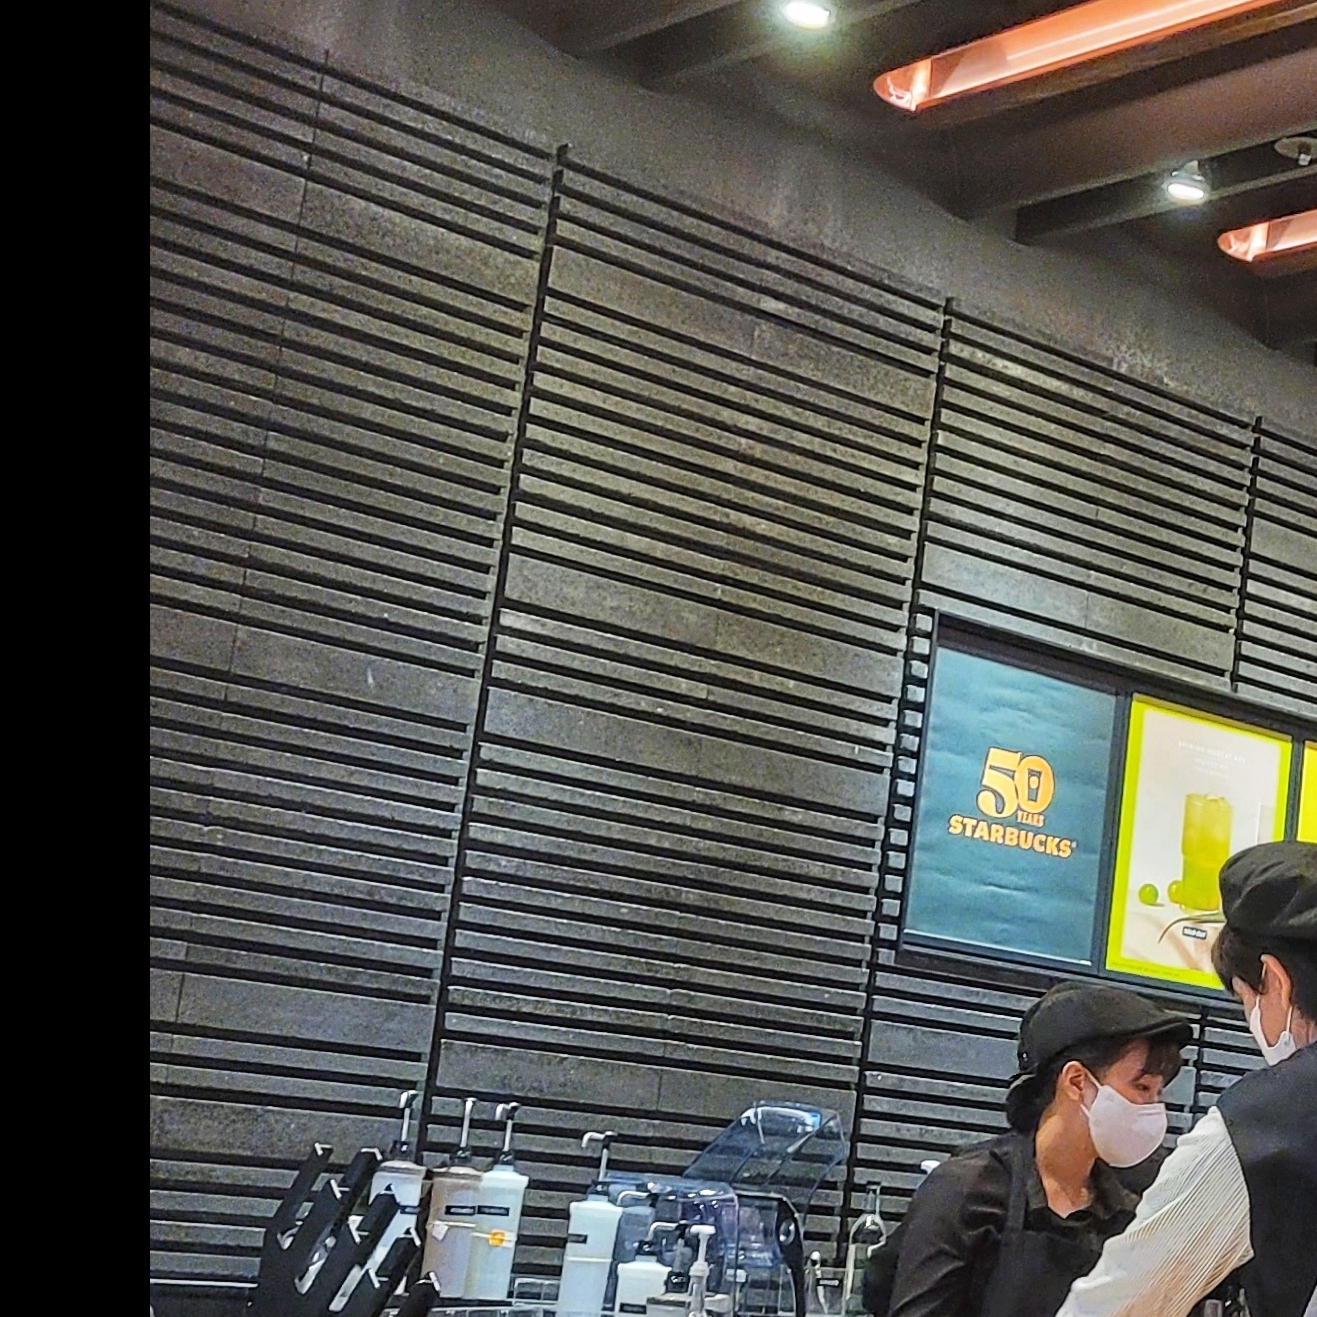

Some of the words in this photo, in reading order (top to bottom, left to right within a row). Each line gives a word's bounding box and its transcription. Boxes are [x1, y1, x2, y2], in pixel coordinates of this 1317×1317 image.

[976, 746, 1055, 818] 50
[948, 813, 1074, 858] STARBUCKS
[1016, 809, 1045, 827] YEARS
